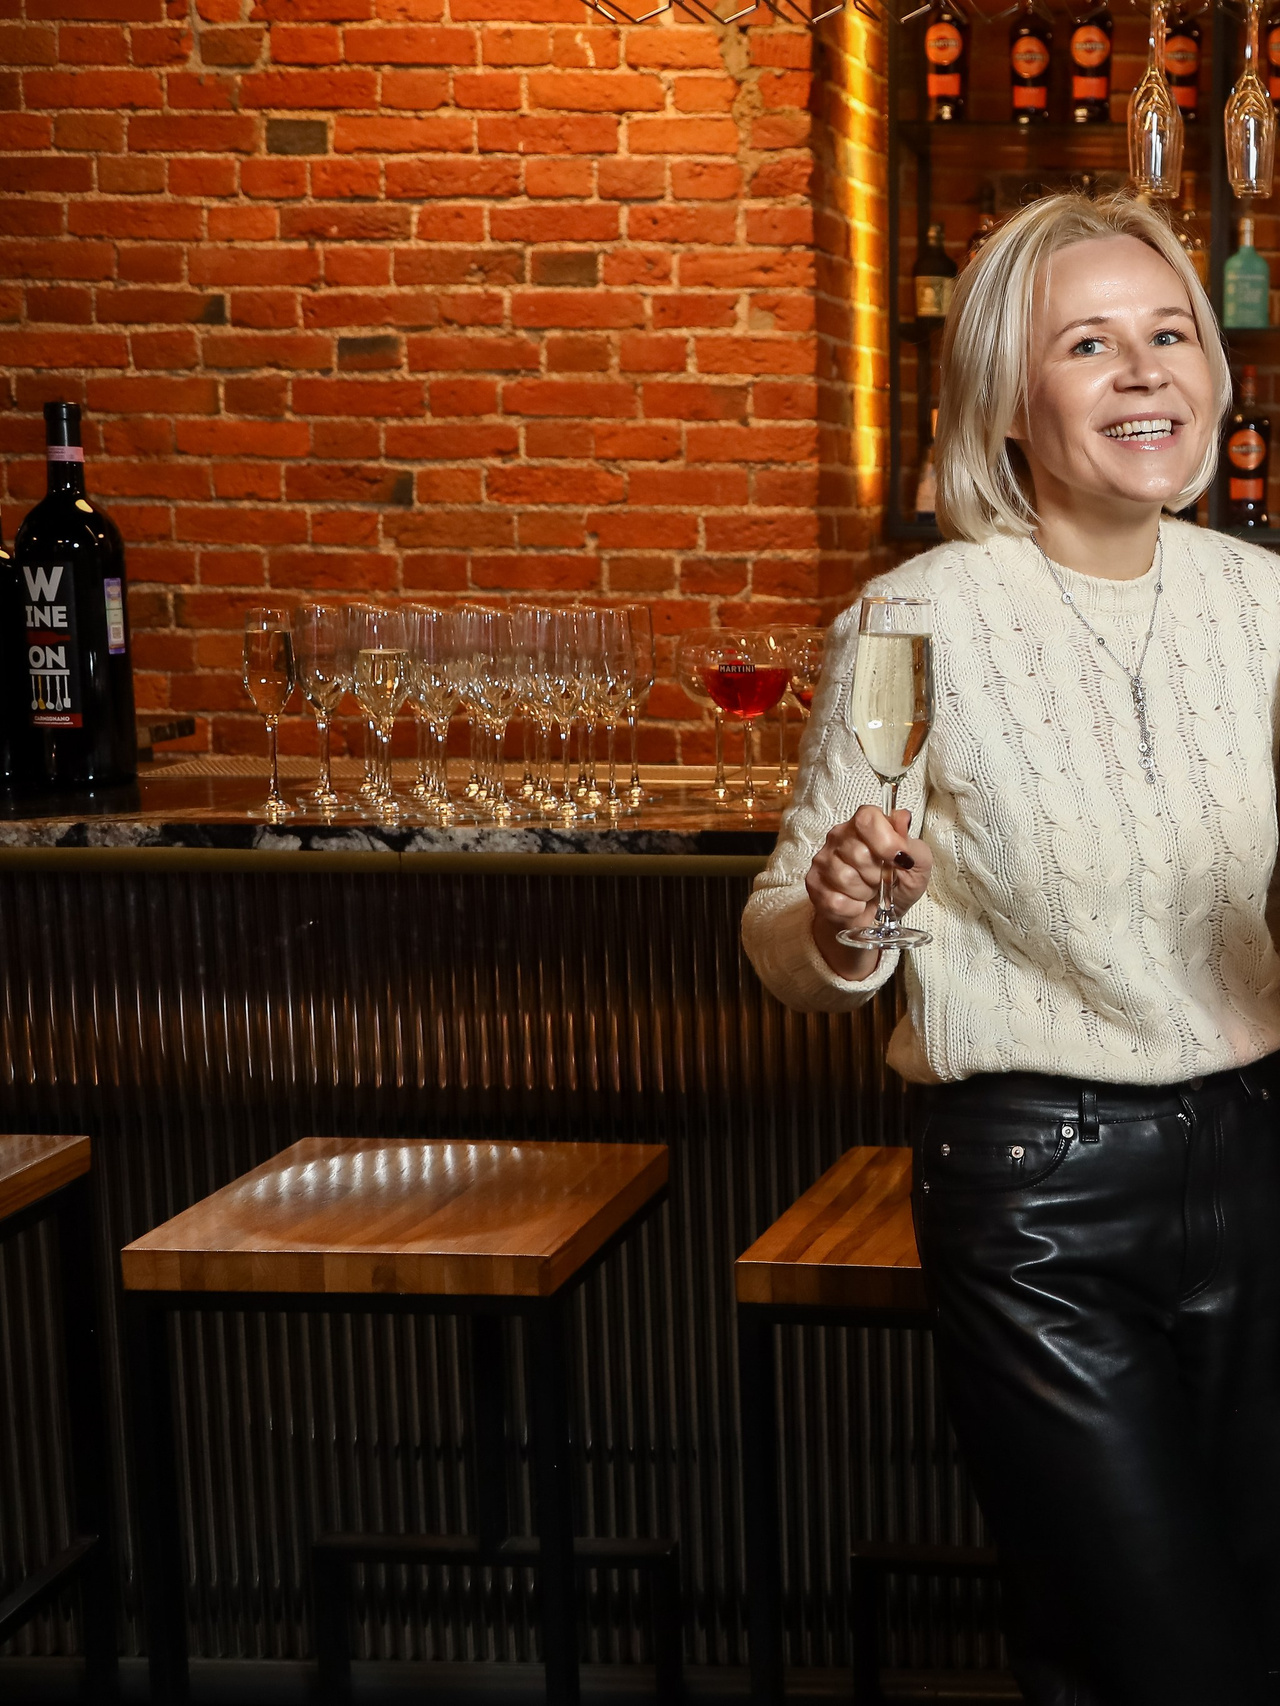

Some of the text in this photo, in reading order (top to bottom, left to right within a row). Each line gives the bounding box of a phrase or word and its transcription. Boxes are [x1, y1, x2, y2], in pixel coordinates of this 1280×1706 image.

[23, 566, 64, 602] W
[25, 605, 68, 628] INE
[28, 645, 66, 668] ON
[719, 665, 754, 673] MARTINI
